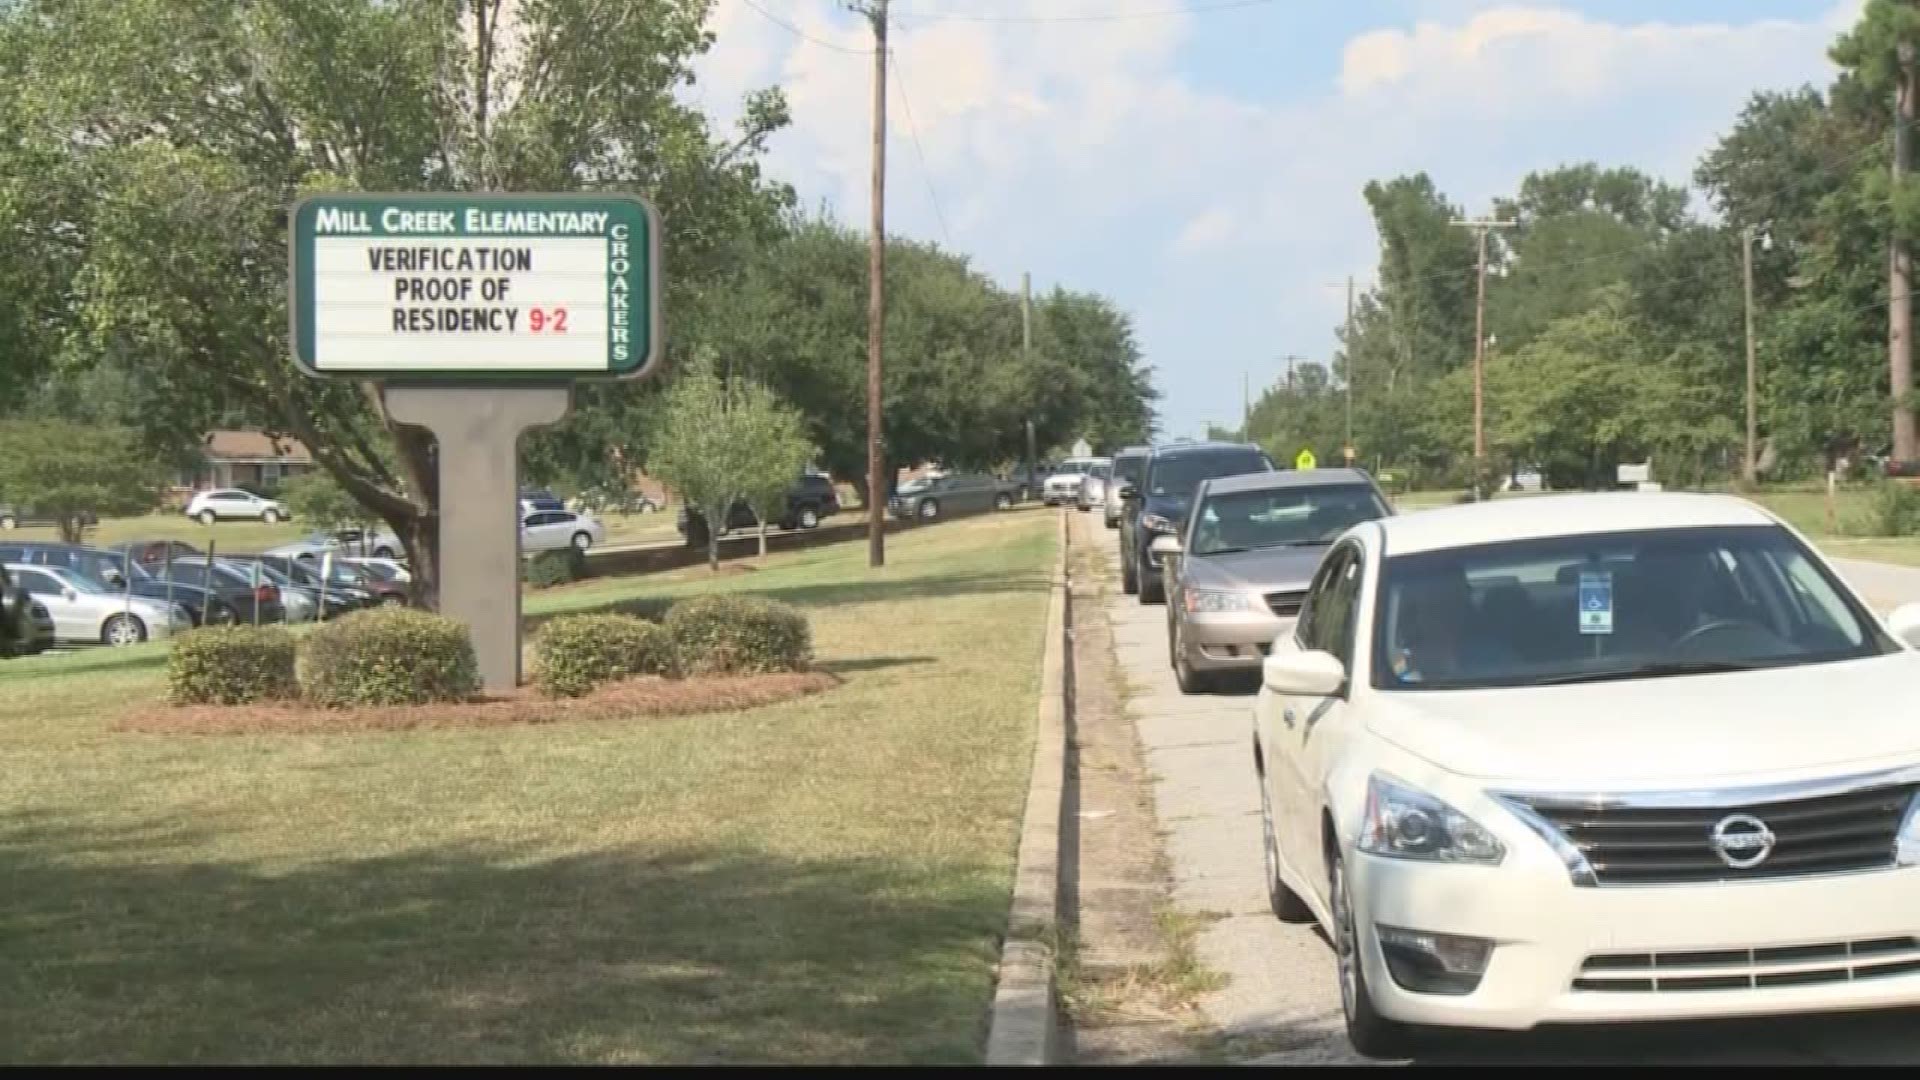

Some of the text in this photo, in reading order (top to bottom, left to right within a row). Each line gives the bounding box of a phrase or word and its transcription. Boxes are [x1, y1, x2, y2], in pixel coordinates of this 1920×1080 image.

[315, 207, 608, 233] MILL CREEK ELEMENTARY
[368, 247, 532, 271] VERIFICATION
[394, 278, 511, 300] PROOF OF
[610, 223, 629, 361] CROAKERS
[392, 308, 518, 332] RESIDENCY
